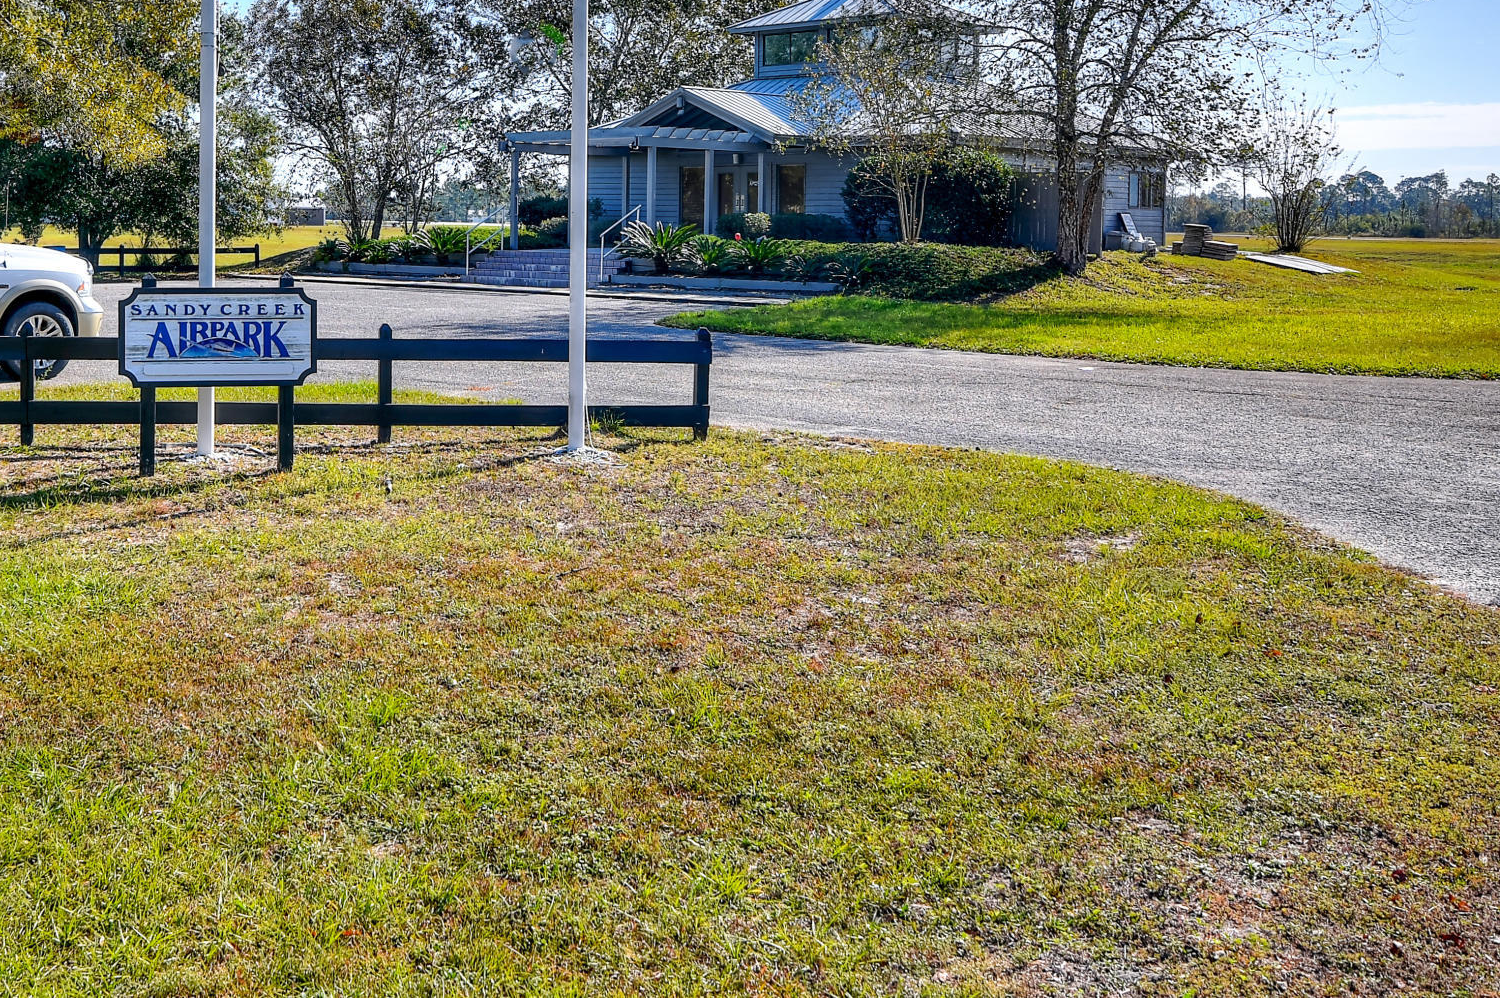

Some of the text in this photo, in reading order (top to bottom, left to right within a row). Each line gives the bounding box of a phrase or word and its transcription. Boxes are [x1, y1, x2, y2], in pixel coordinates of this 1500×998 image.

[130, 303, 305, 316] SANDY CREEK
[146, 320, 291, 358] AIRPARK
